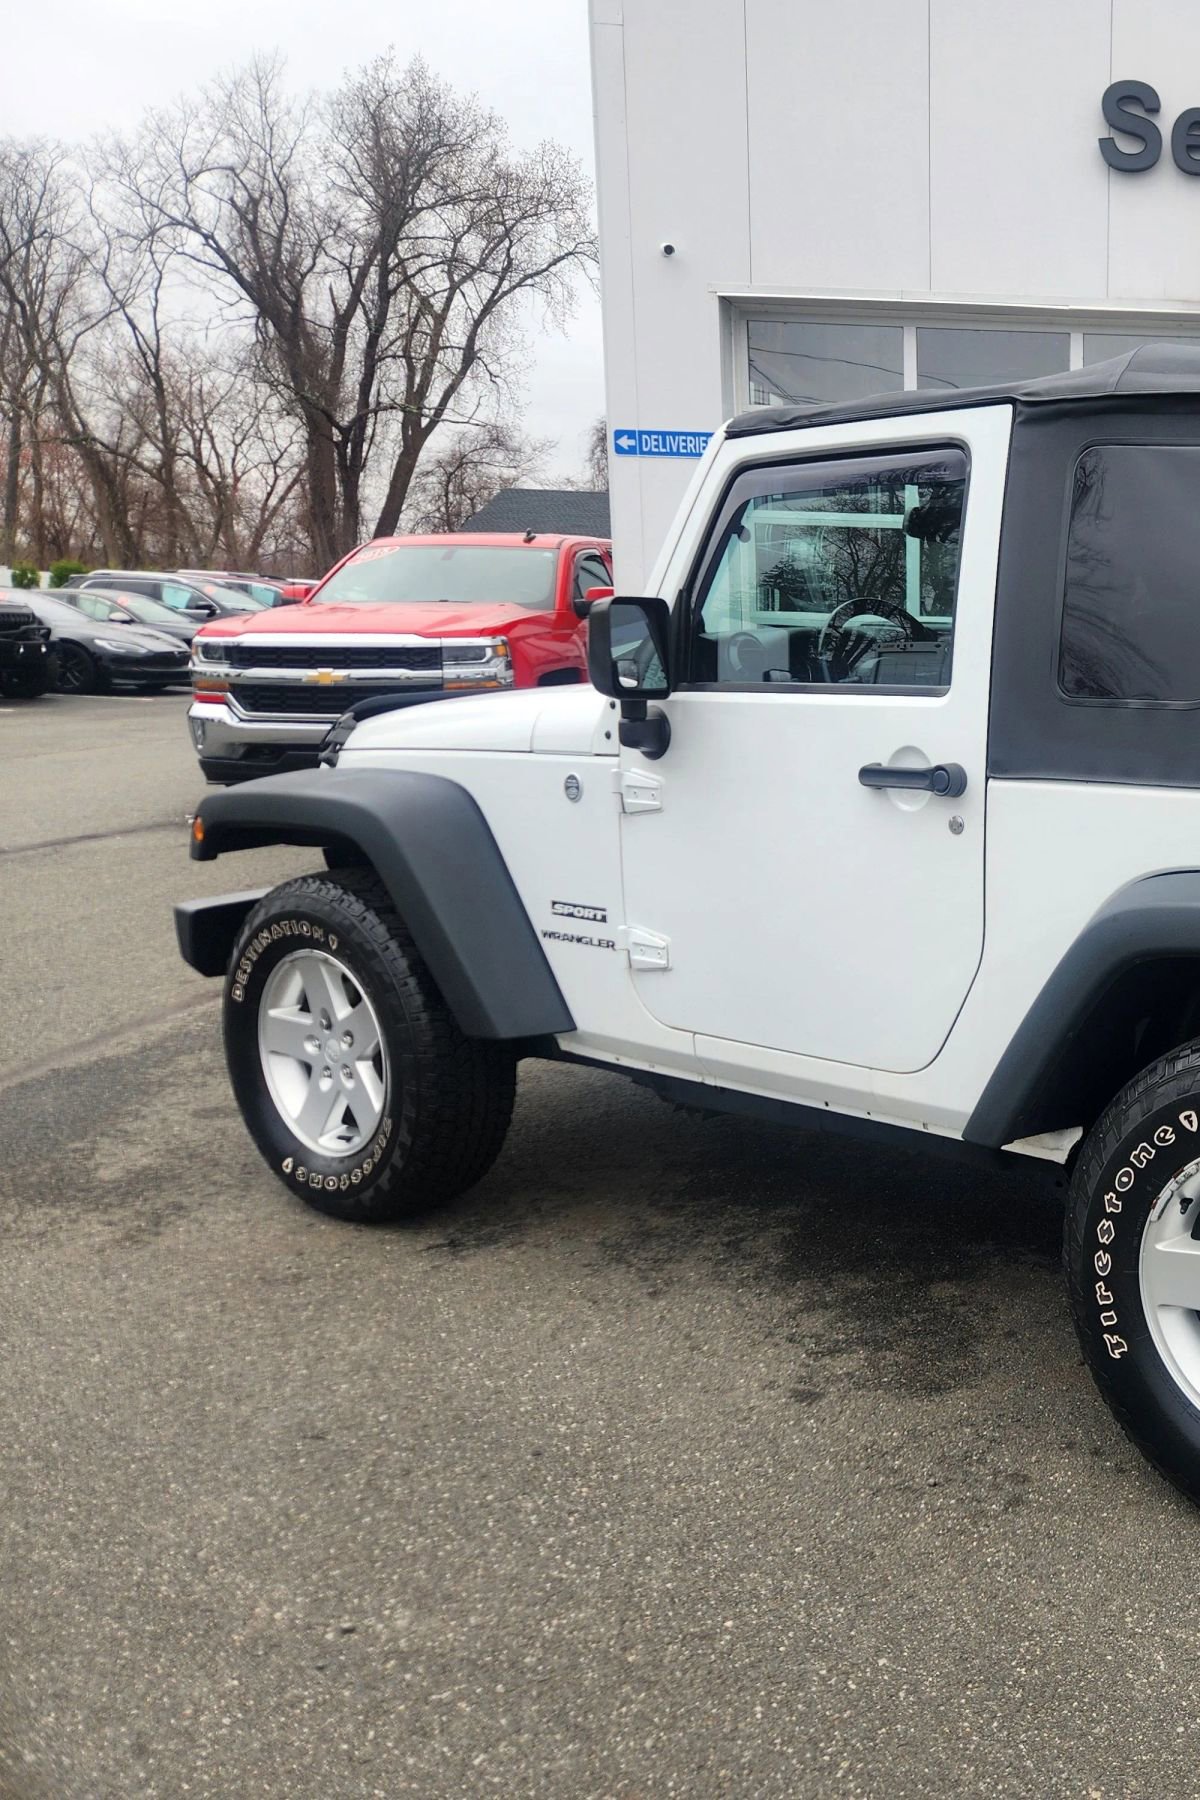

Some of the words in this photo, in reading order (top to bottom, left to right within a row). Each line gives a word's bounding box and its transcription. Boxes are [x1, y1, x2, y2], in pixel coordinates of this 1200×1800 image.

[551, 902, 607, 922] SPORT
[231, 920, 325, 1001] DESTINATION
[541, 929, 616, 951] WRANGLER
[1094, 1125, 1176, 1359] Firestone
